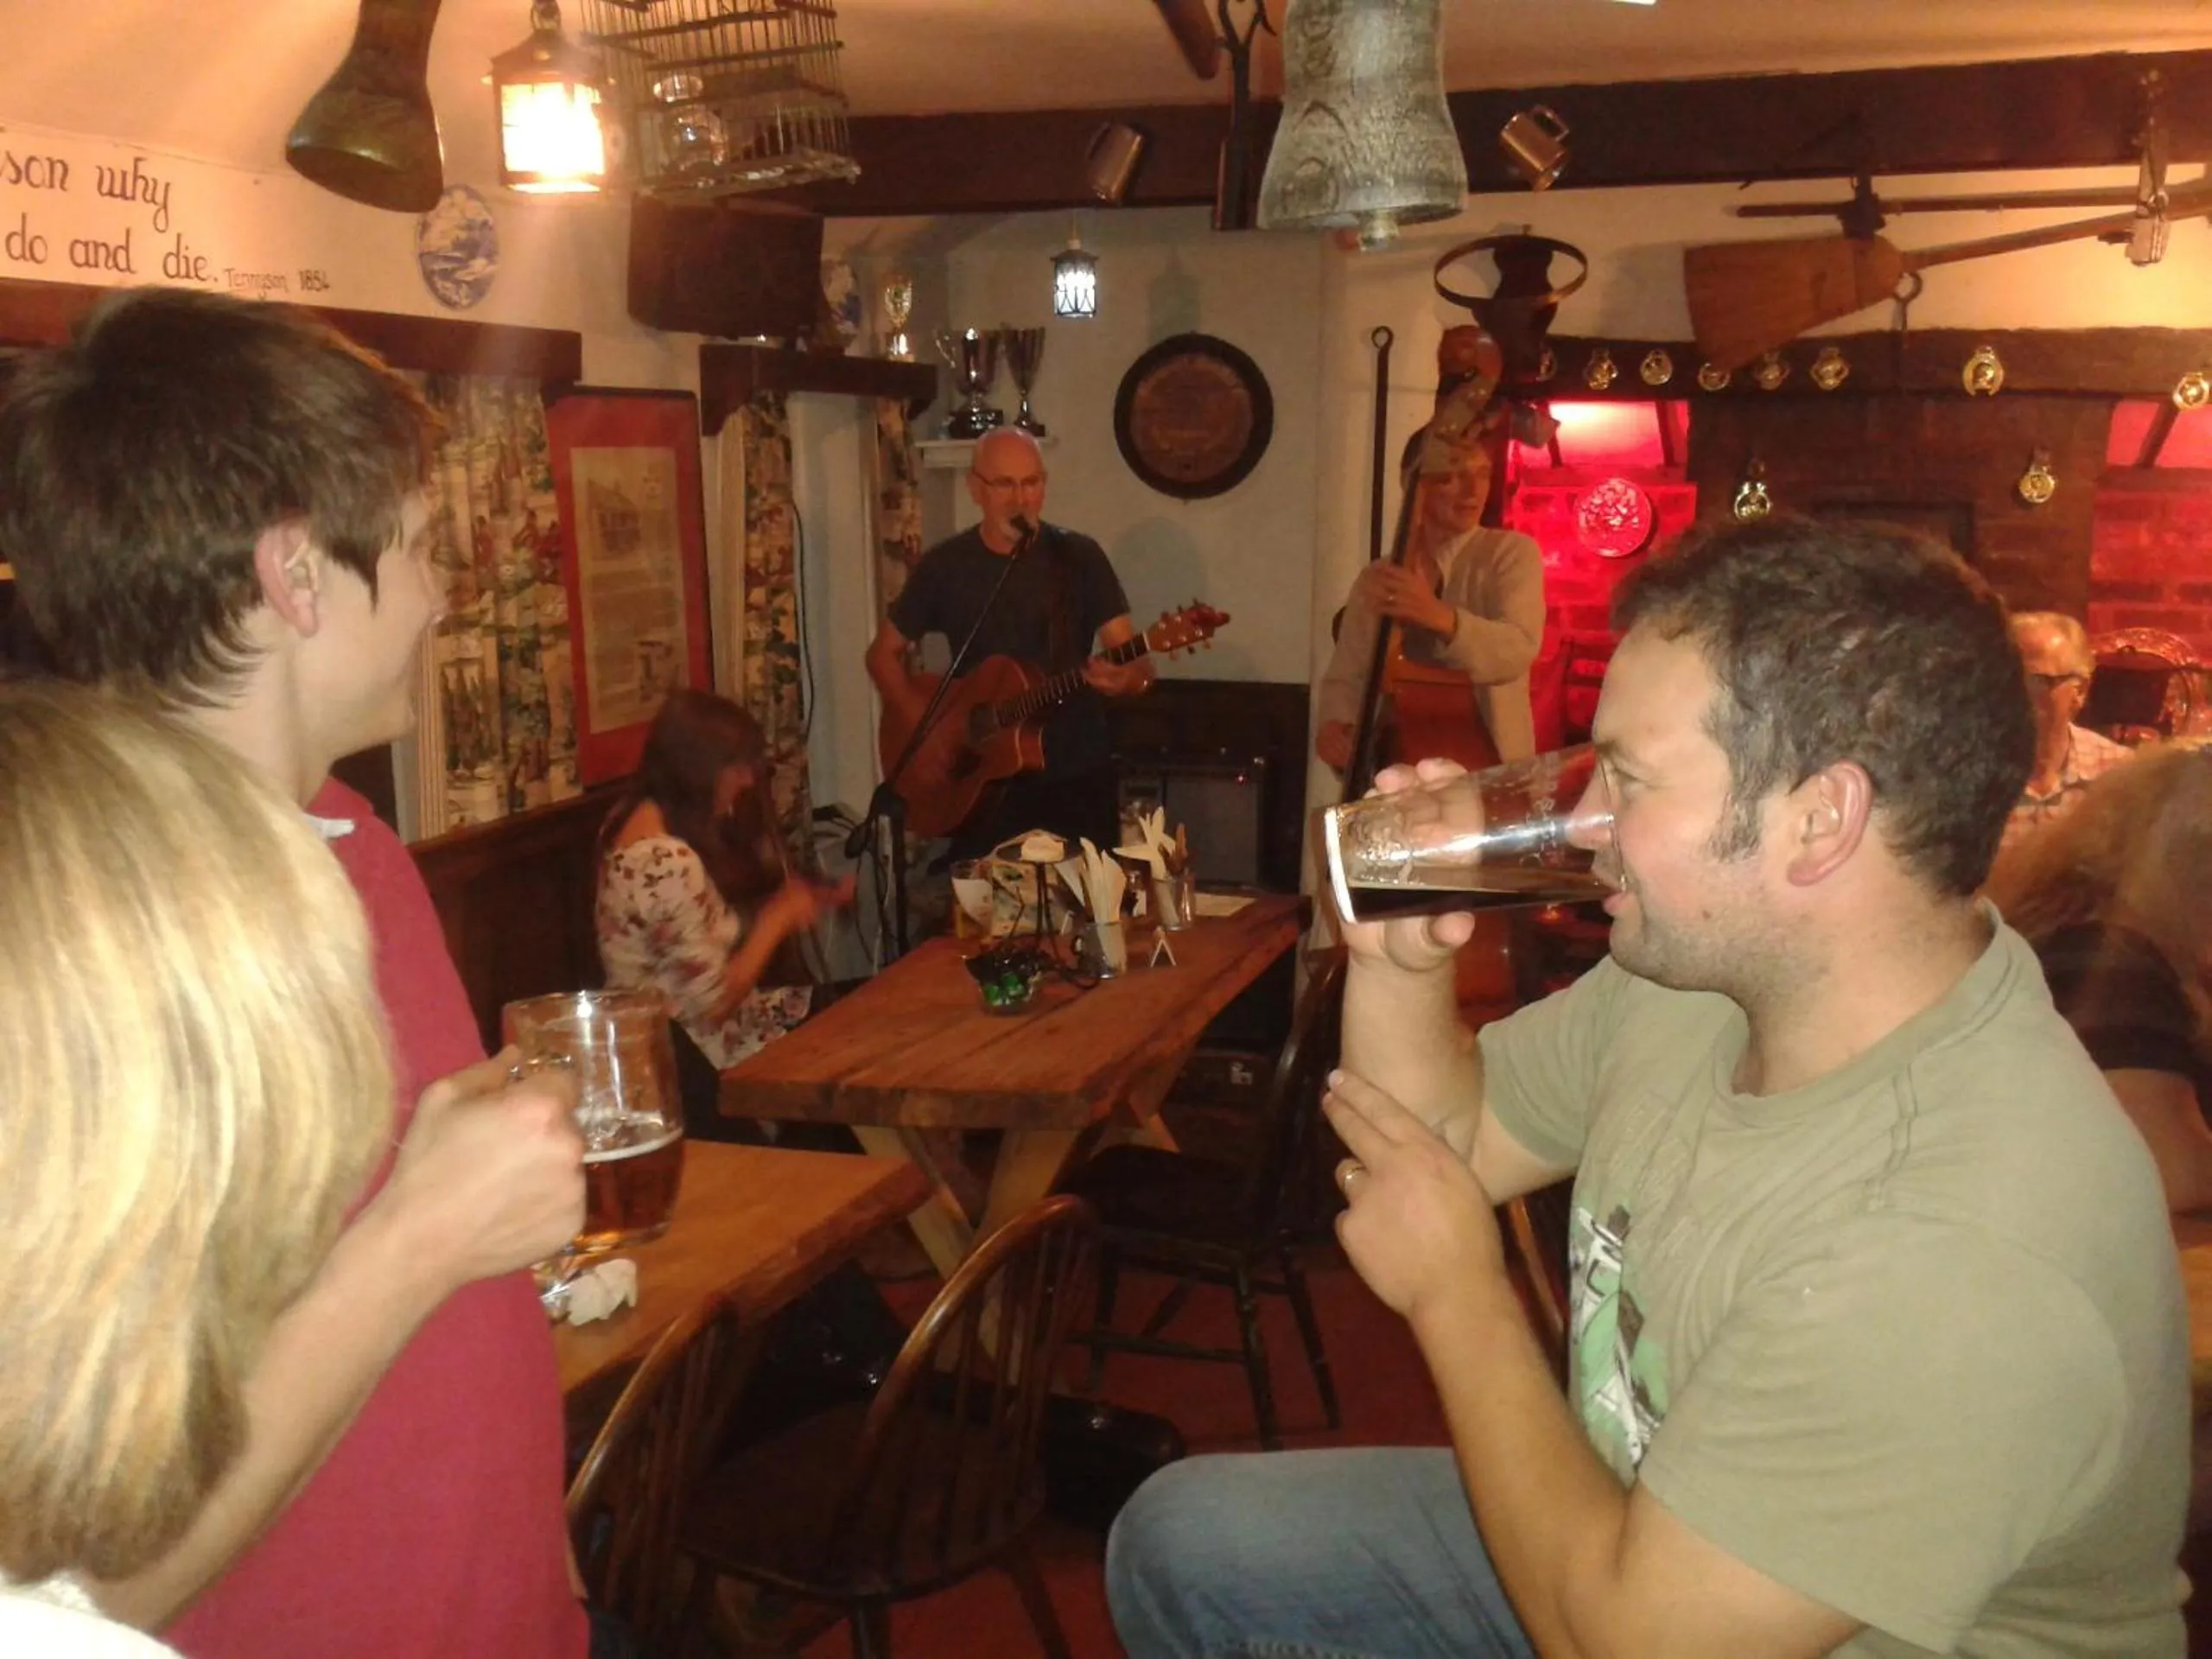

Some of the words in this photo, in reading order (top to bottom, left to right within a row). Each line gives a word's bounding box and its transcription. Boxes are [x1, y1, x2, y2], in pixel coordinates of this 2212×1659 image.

[96, 156, 171, 233] why
[5, 212, 48, 264] do
[69, 226, 137, 275] and
[162, 232, 219, 282] die.
